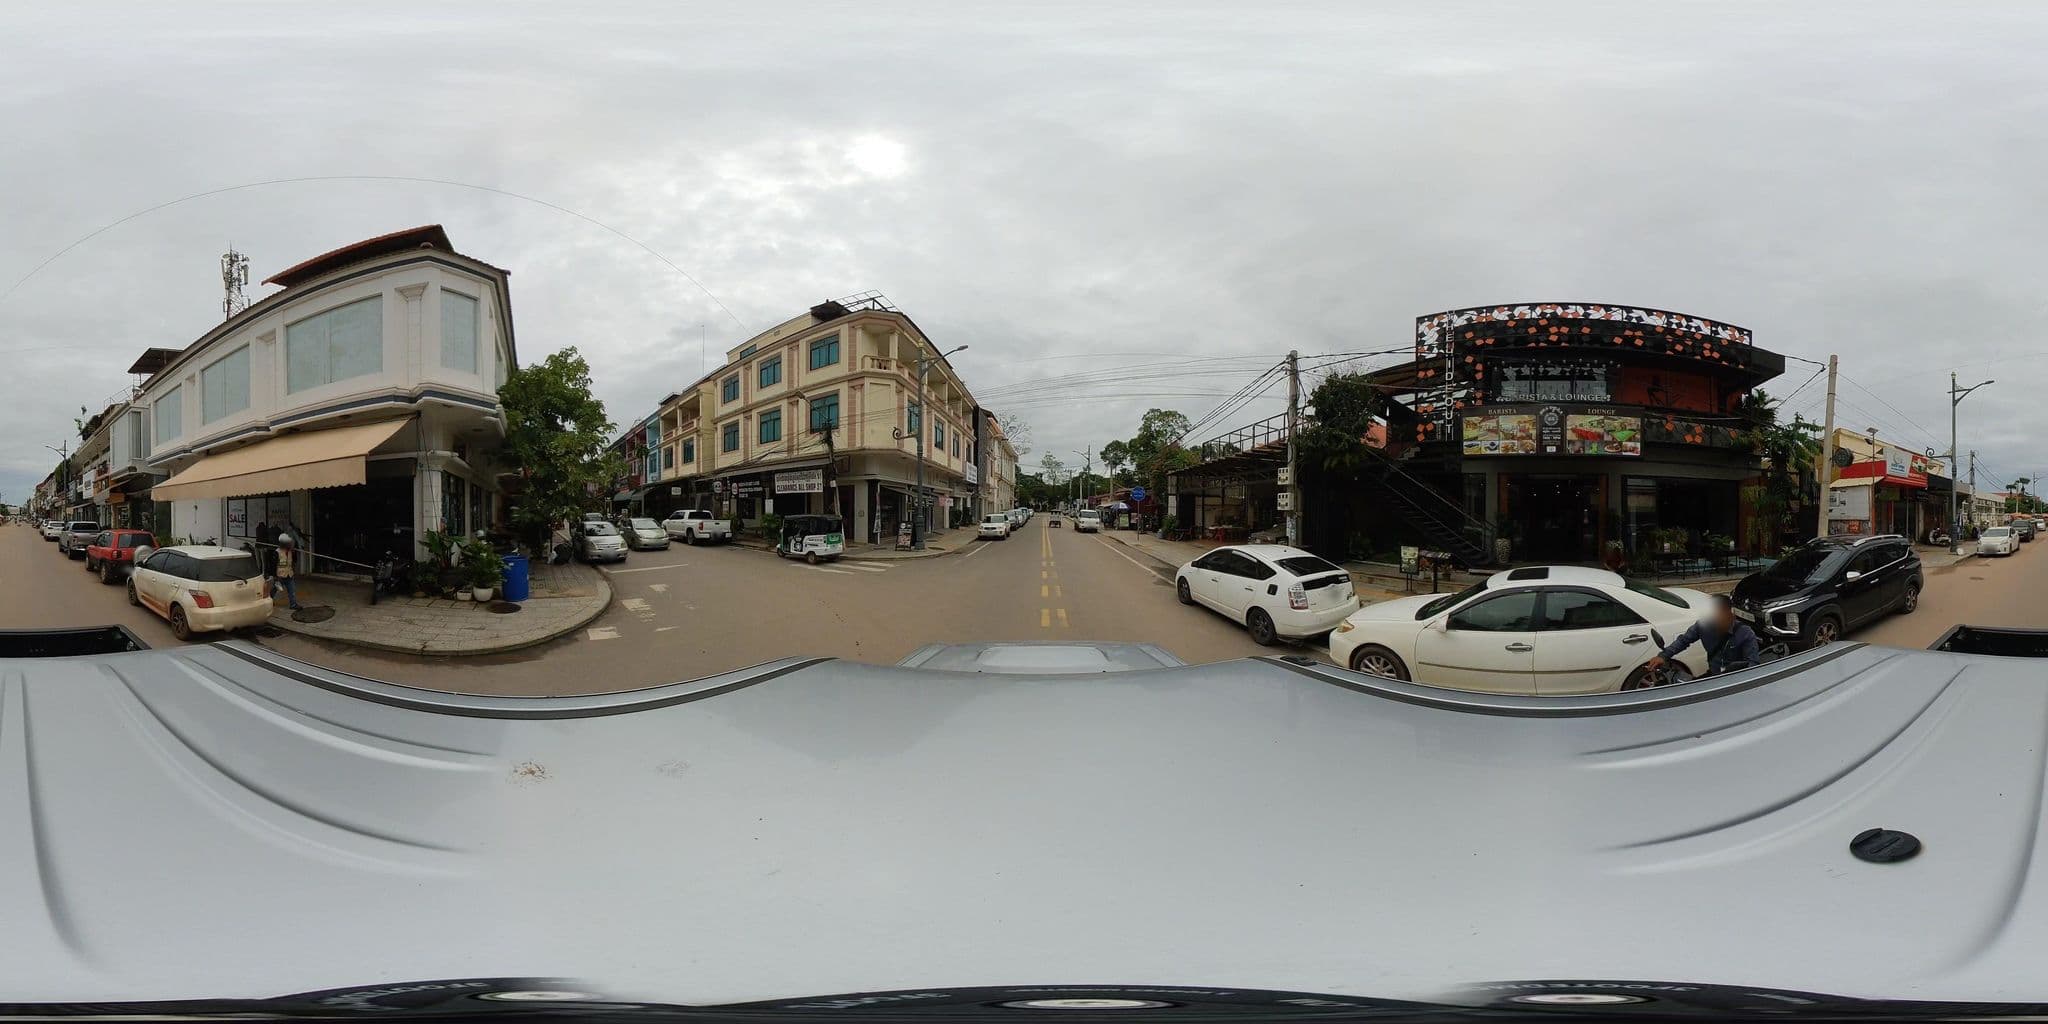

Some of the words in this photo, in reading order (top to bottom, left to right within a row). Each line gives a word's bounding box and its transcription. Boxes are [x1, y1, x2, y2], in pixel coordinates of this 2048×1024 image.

[1550, 393, 1557, 401] &
[1559, 393, 1602, 402] LOUNGE
[229, 513, 245, 523] SALE
